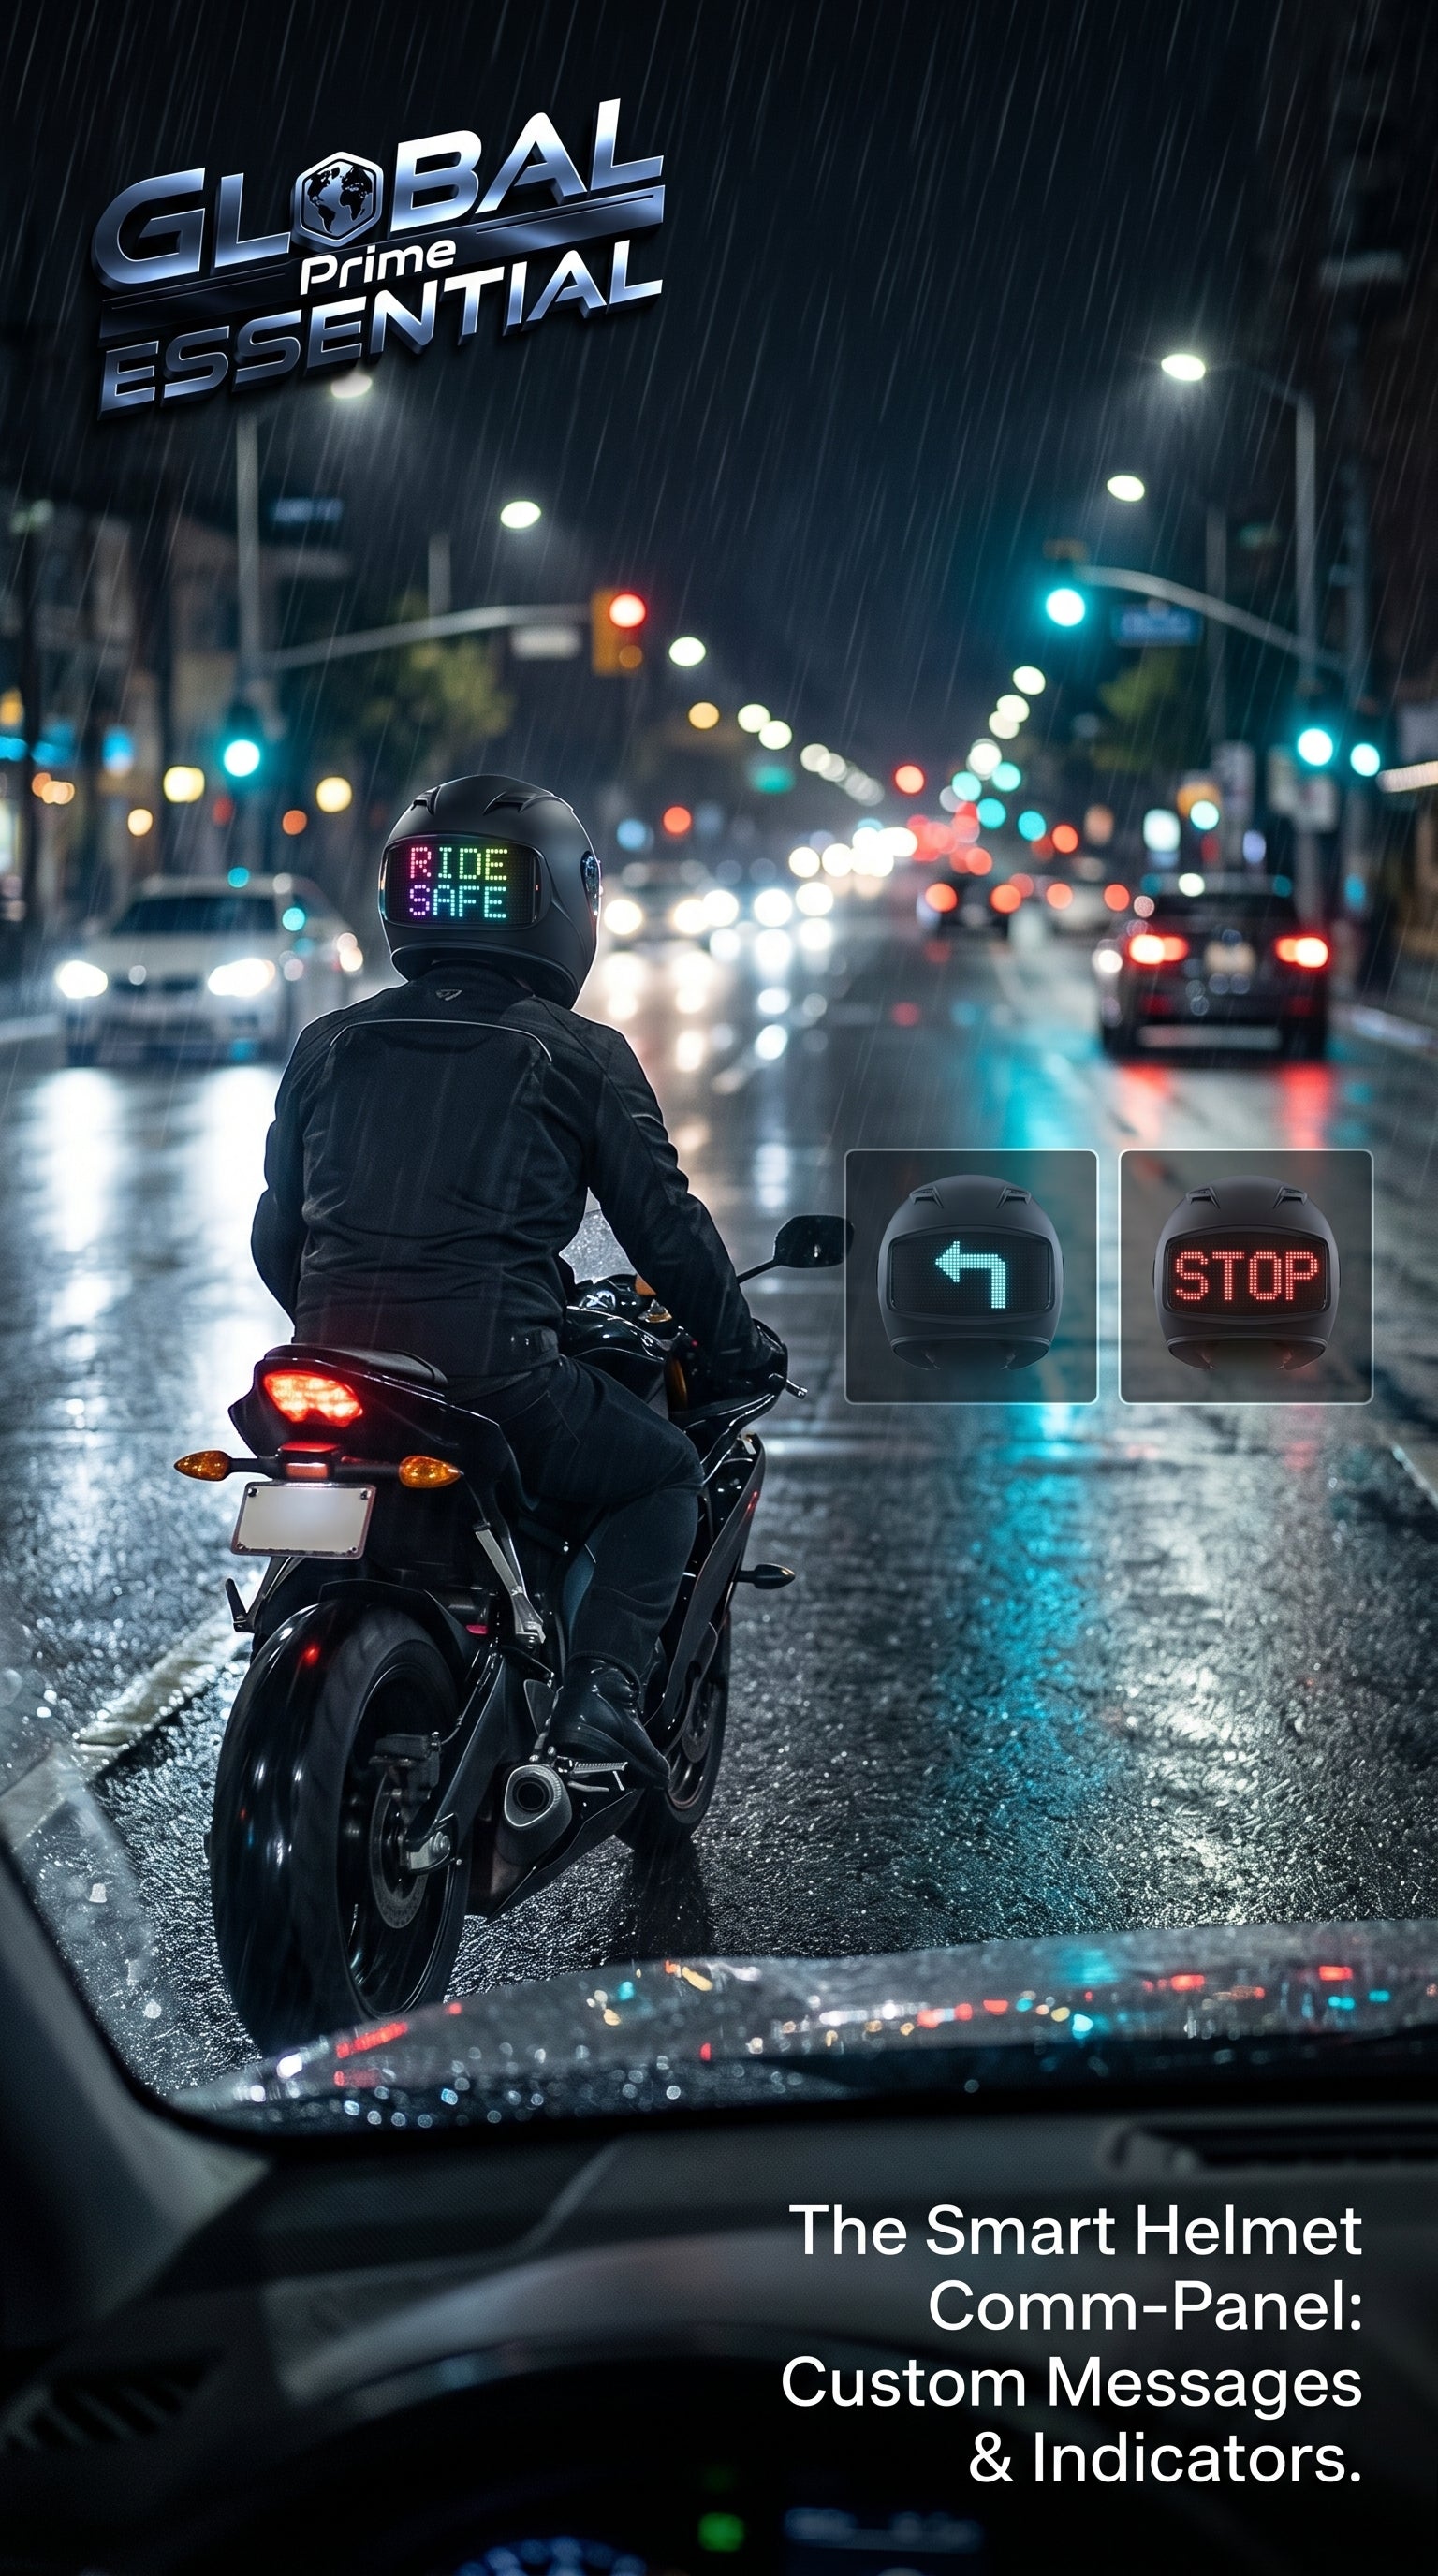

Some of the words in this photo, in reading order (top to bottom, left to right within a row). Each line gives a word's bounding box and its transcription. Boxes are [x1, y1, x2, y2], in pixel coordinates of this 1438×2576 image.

[409, 846, 508, 881] RIDE
[409, 884, 506, 919] SAFE
[1174, 1251, 1319, 1301] STOP
